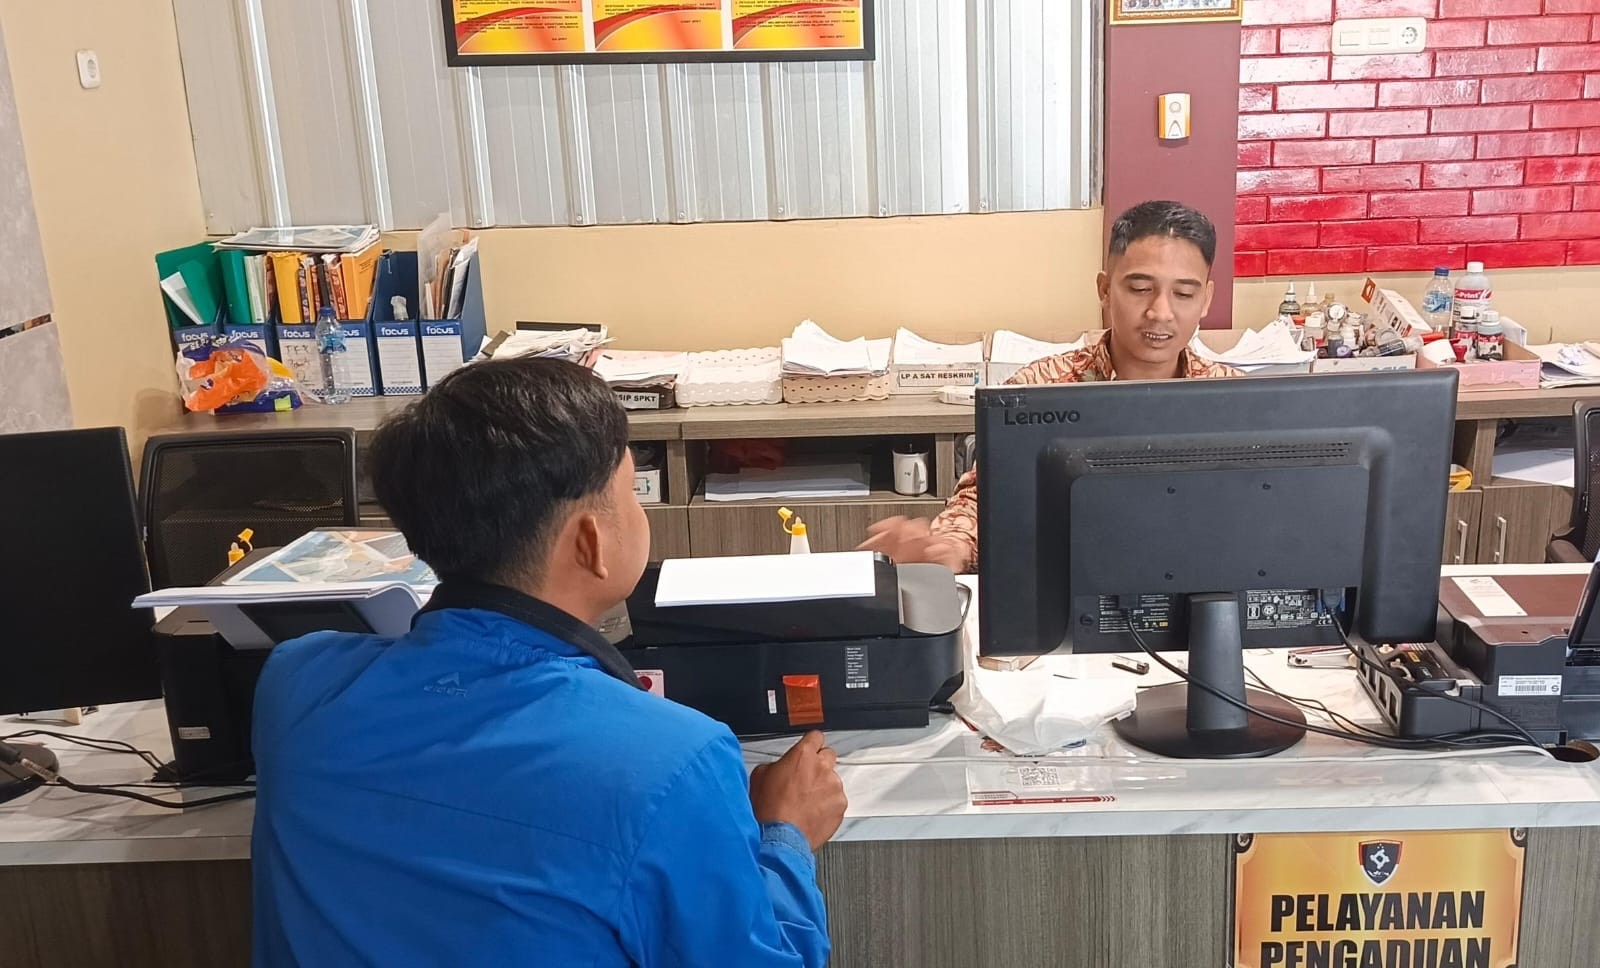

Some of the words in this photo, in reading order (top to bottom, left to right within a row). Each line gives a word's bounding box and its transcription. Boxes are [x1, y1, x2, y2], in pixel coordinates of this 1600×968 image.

[231, 329, 260, 339] focus
[283, 329, 311, 338] focus
[381, 326, 409, 336] focus
[426, 326, 454, 334] focus
[1004, 409, 1080, 425] Lenovo
[1271, 891, 1485, 932] PELAYANAN
[1260, 937, 1491, 968] PENGADUAN
